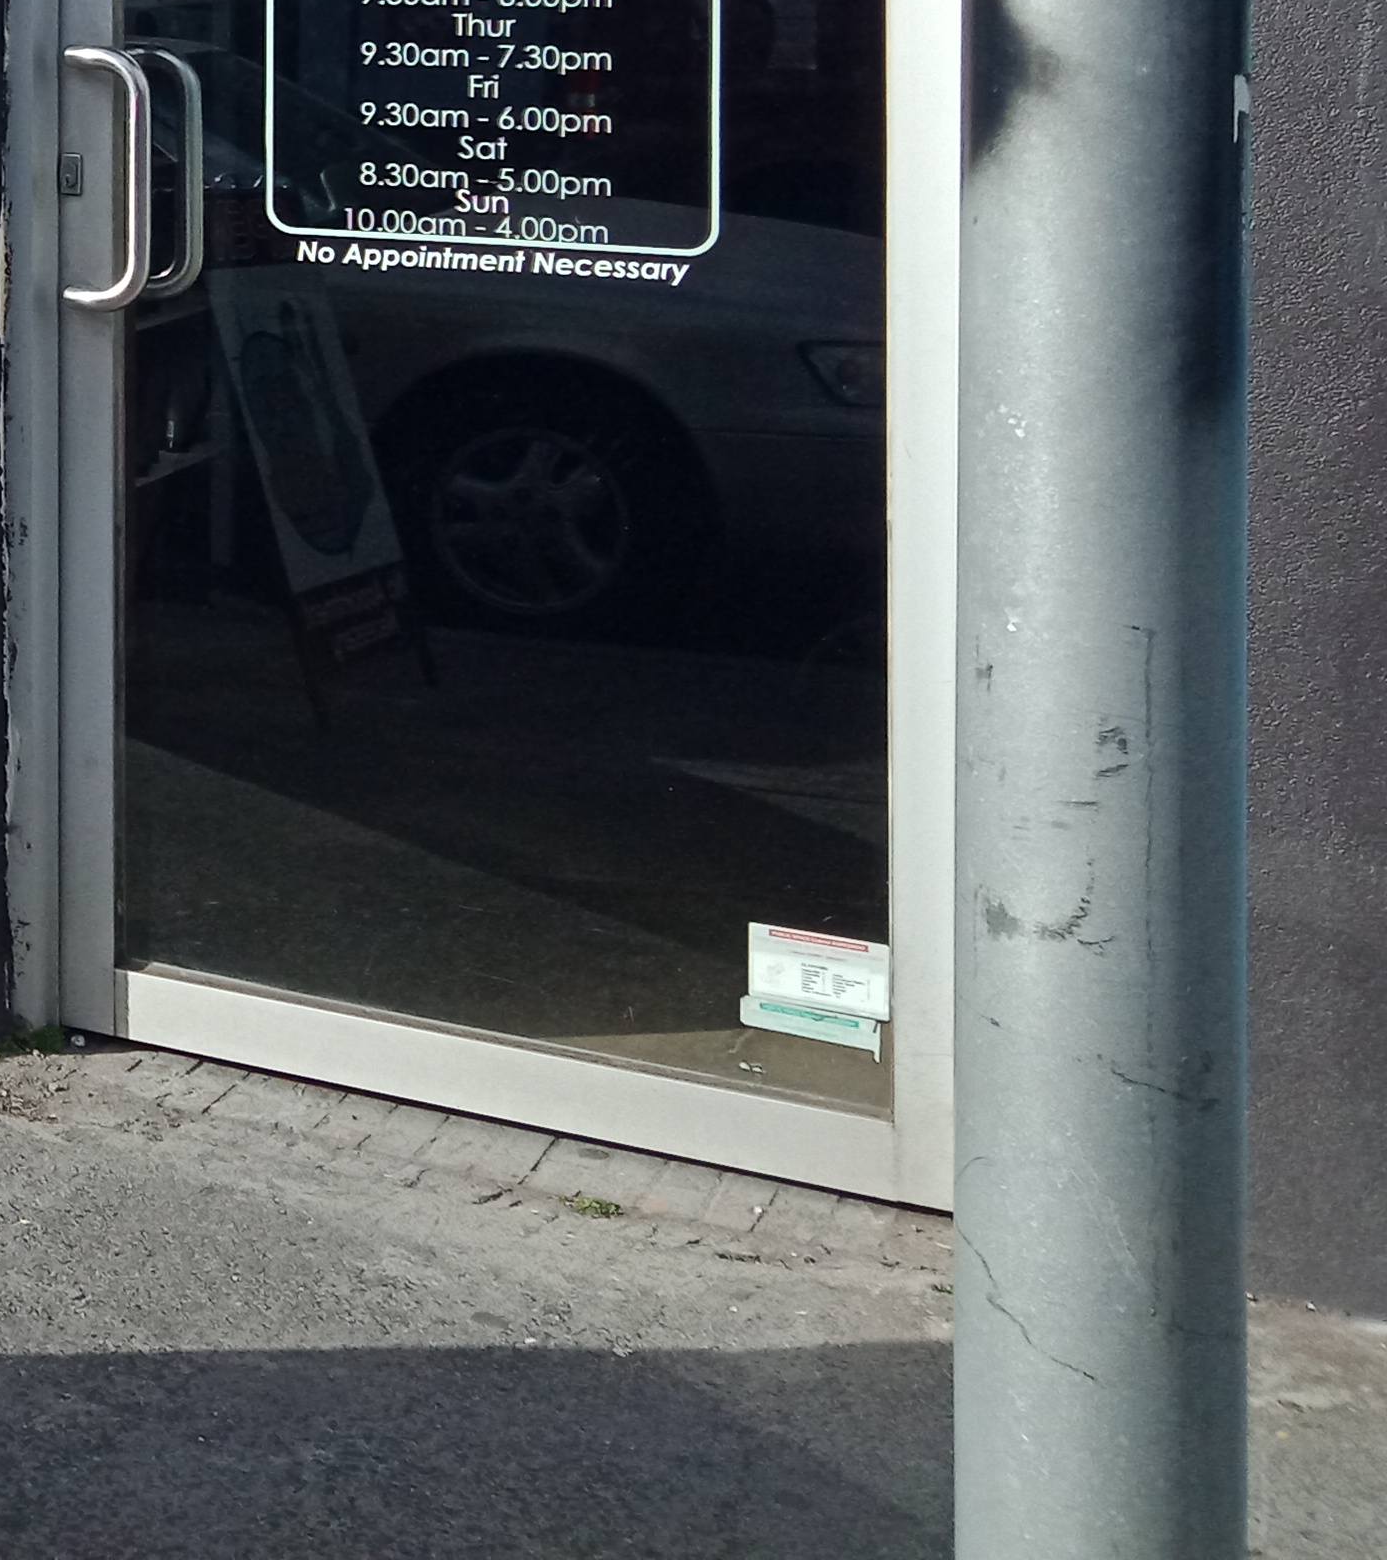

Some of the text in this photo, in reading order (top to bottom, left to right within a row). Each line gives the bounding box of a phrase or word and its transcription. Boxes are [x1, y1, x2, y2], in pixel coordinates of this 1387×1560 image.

[452, 13, 517, 38] Thur
[360, 42, 470, 68] 9.30am
[497, 44, 613, 75] 7.30pm
[467, 74, 500, 100] Fri
[360, 102, 470, 129] 9.30am
[497, 105, 613, 136] 6.00pm
[457, 136, 508, 161] Sat
[360, 163, 470, 190] 8.30am
[496, 167, 612, 198] 5.00pm
[454, 189, 509, 215] Sun
[344, 207, 466, 236] 10.00am
[493, 216, 609, 244] 4.00pm
[297, 240, 690, 287] No Appointment Necessary
